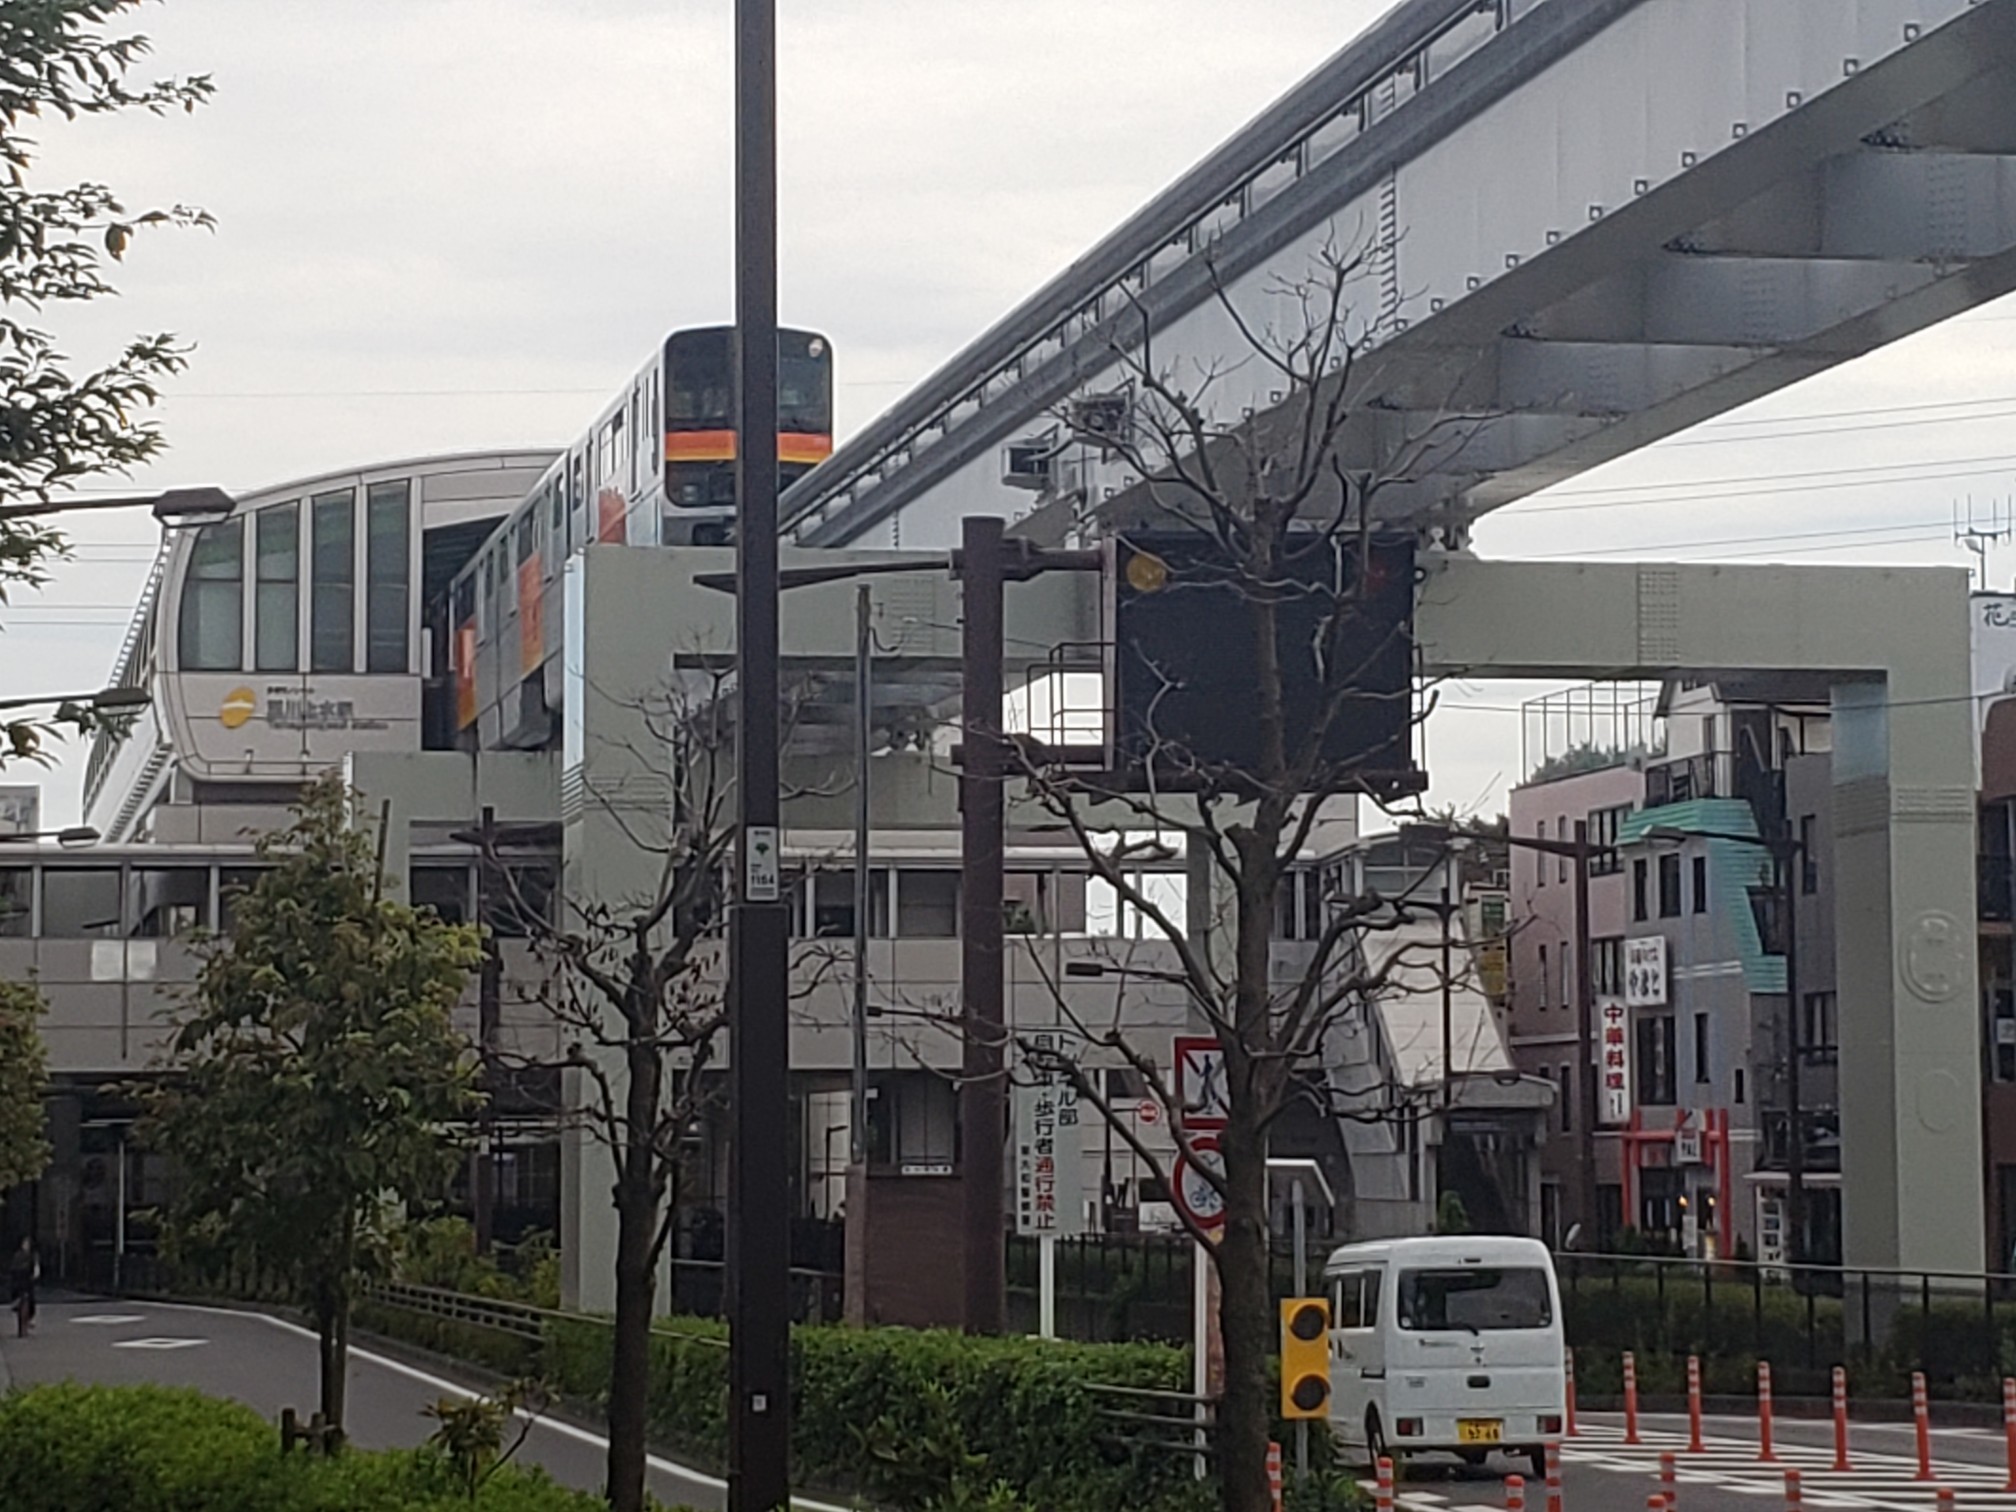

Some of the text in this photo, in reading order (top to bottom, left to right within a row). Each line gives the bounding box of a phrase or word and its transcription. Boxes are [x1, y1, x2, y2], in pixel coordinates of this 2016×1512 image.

[1982, 603, 2016, 627] 花
[1059, 1034, 1079, 1126] トル部
[1604, 1003, 1625, 1090] 中華料理
[1035, 1034, 1056, 1229] 自車・歩行者通行禁止
